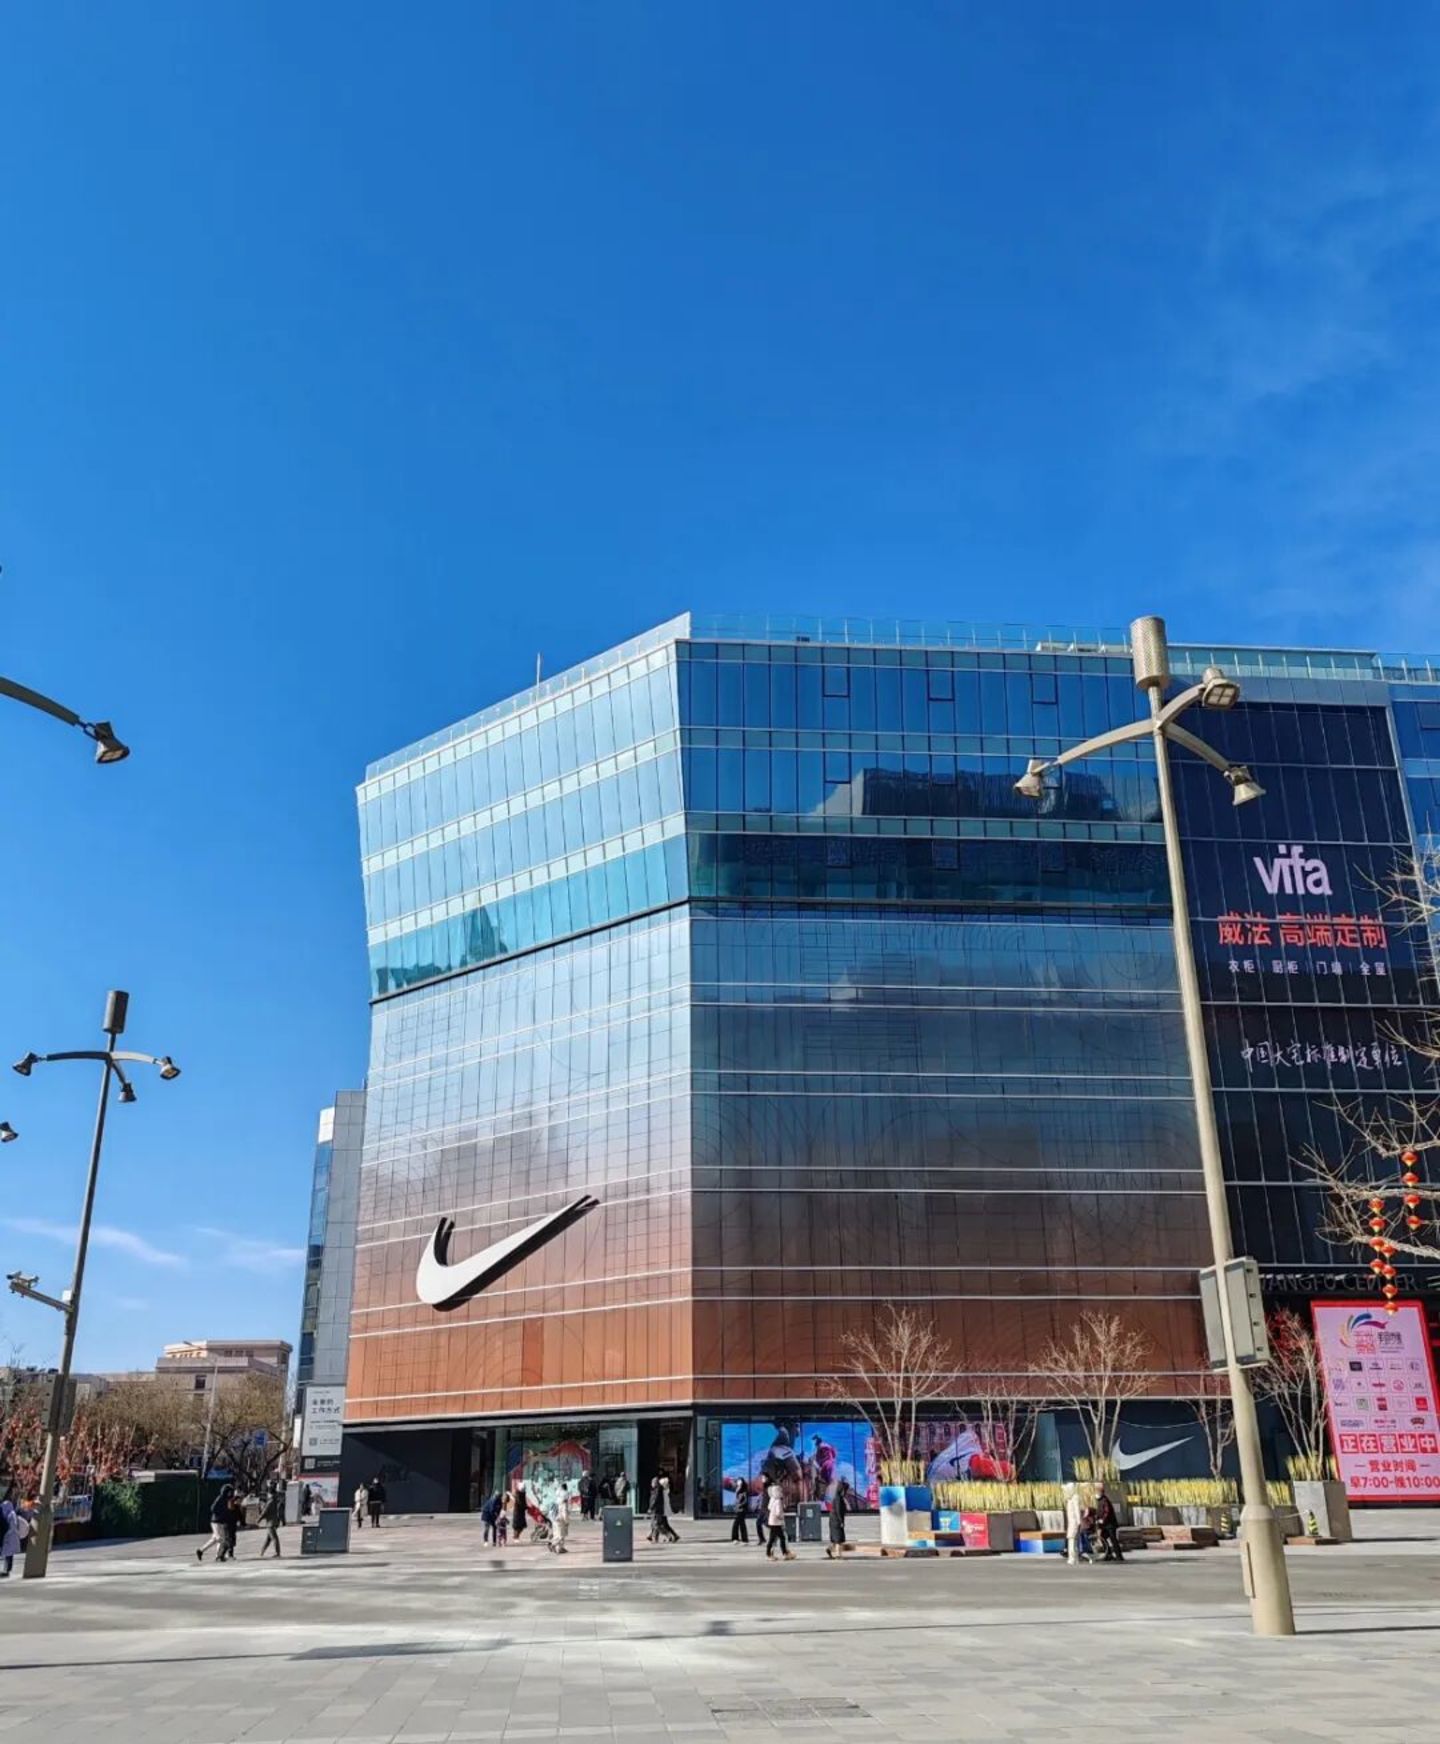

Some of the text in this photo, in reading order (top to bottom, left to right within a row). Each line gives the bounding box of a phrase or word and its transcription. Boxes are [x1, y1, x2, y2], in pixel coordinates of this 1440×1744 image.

[1253, 844, 1333, 895] vifa
[1217, 911, 1388, 949] 威法 高端定制
[1343, 1273, 1418, 1291] CENER
[1341, 1434, 1437, 1453] 正在营业中
[1369, 1459, 1417, 1472] 营业时间
